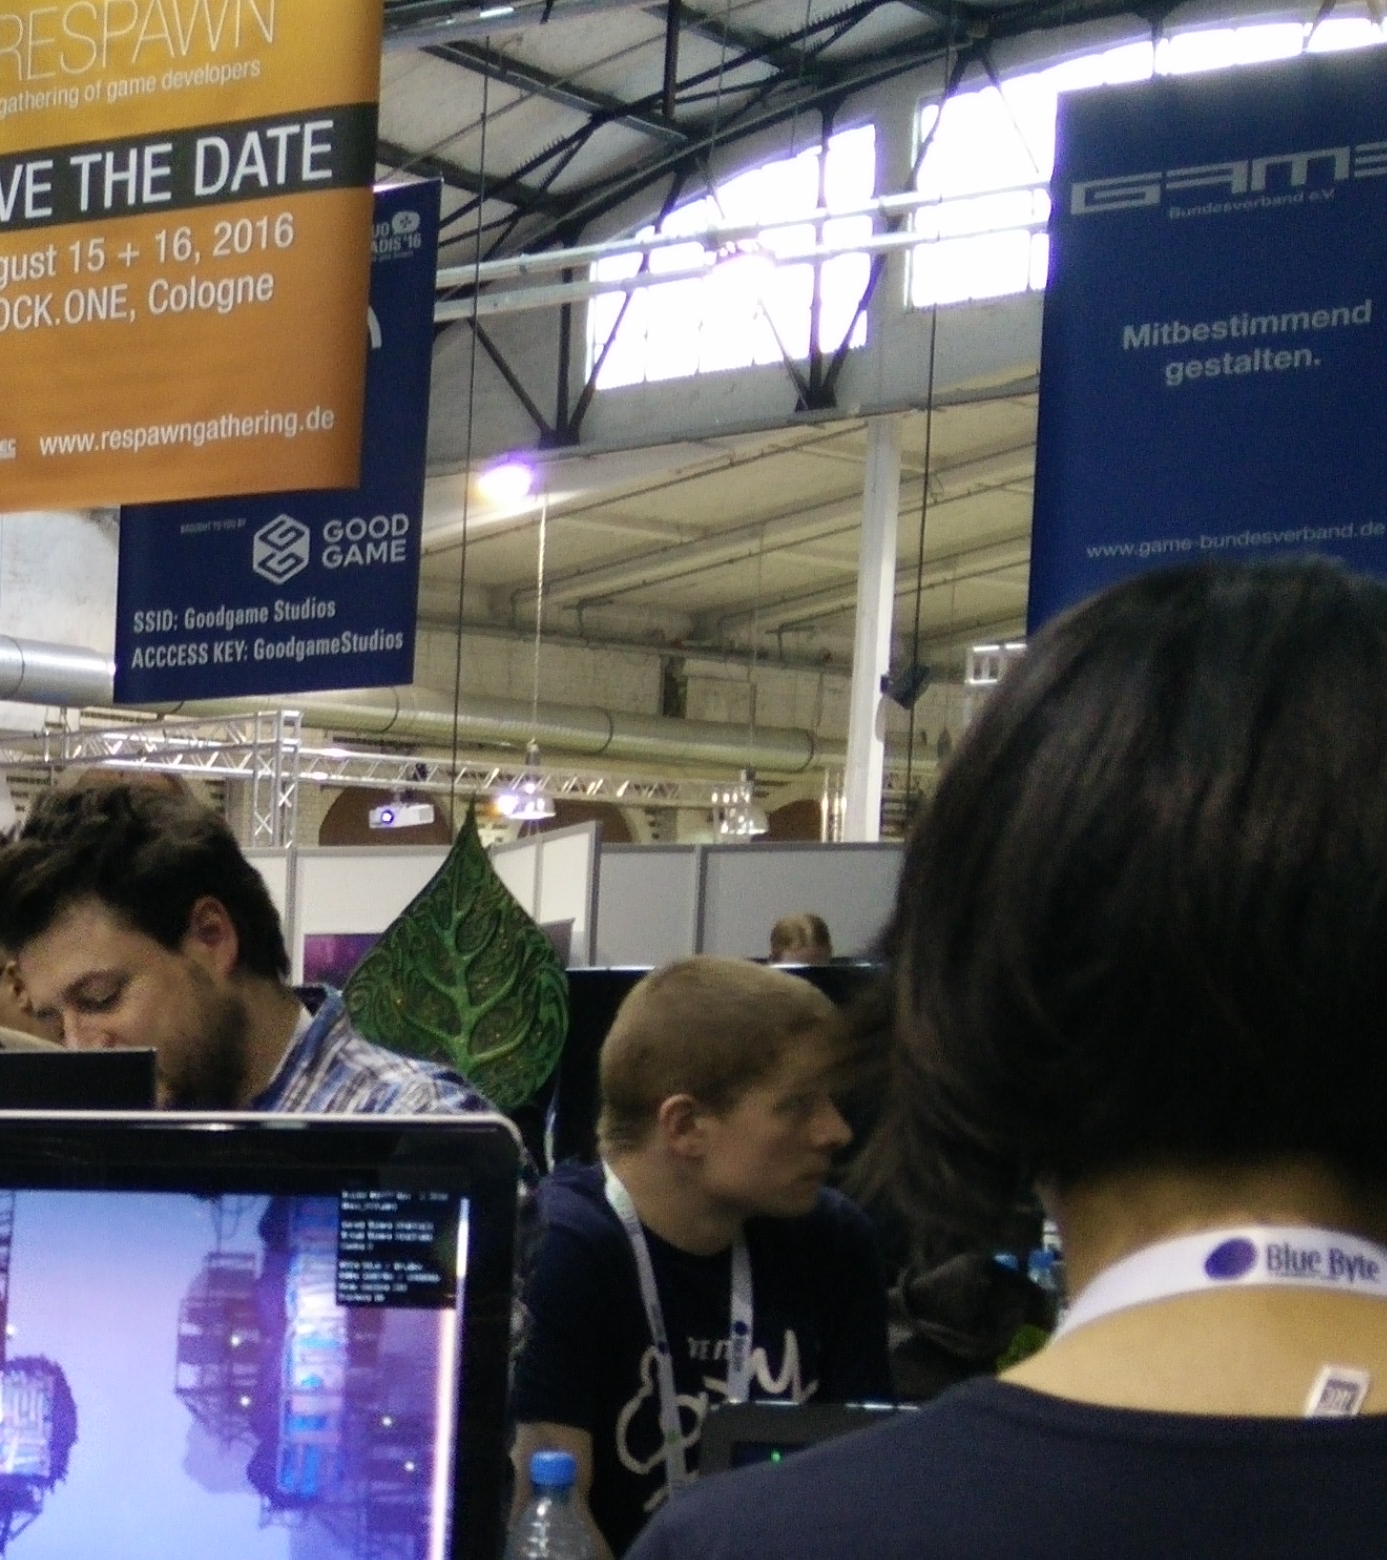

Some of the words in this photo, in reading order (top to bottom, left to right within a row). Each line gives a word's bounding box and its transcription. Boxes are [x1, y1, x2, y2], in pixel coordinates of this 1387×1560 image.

[84, 81, 102, 101] of
[106, 76, 156, 102] game
[161, 57, 261, 91] developers
[70, 143, 173, 211] THE
[193, 120, 334, 197] DATE
[69, 239, 106, 273] 15
[118, 243, 141, 267] +
[155, 228, 201, 264] 16,
[214, 212, 295, 258] 2016
[149, 272, 275, 315] Cologne
[1122, 299, 1373, 351] Mitbestimmend
[1165, 344, 1322, 387] gestalten.
[39, 407, 335, 457] www.respawngathering.de
[322, 513, 410, 543] GOOD
[1086, 521, 1386, 559] www.game-bundesverband.de
[322, 539, 407, 570] GAME
[133, 610, 178, 634] SSID:
[185, 603, 268, 631] Goodgame
[274, 596, 336, 622] Studios
[131, 643, 209, 670] ACCCESS
[213, 640, 248, 664] KEY:
[254, 629, 403, 662] GoodgameStudios
[1266, 1242, 1322, 1272] Blue
[1329, 1247, 1380, 1284] Byte
